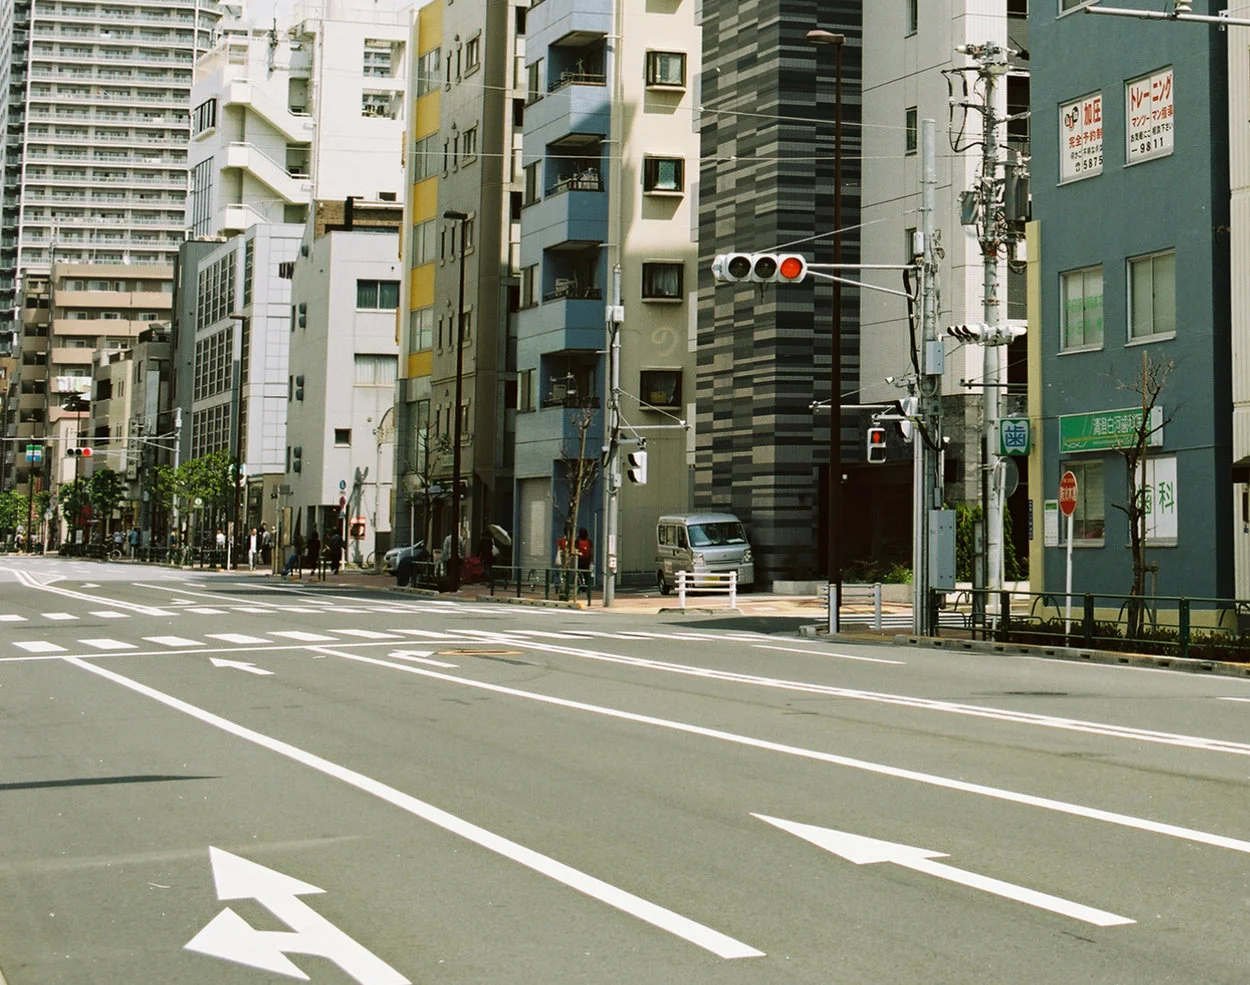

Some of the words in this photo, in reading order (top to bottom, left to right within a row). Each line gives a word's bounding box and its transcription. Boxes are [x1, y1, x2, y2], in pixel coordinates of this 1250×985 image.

[1131, 74, 1173, 112] トレーニング
[1004, 424, 1026, 448] 歯
